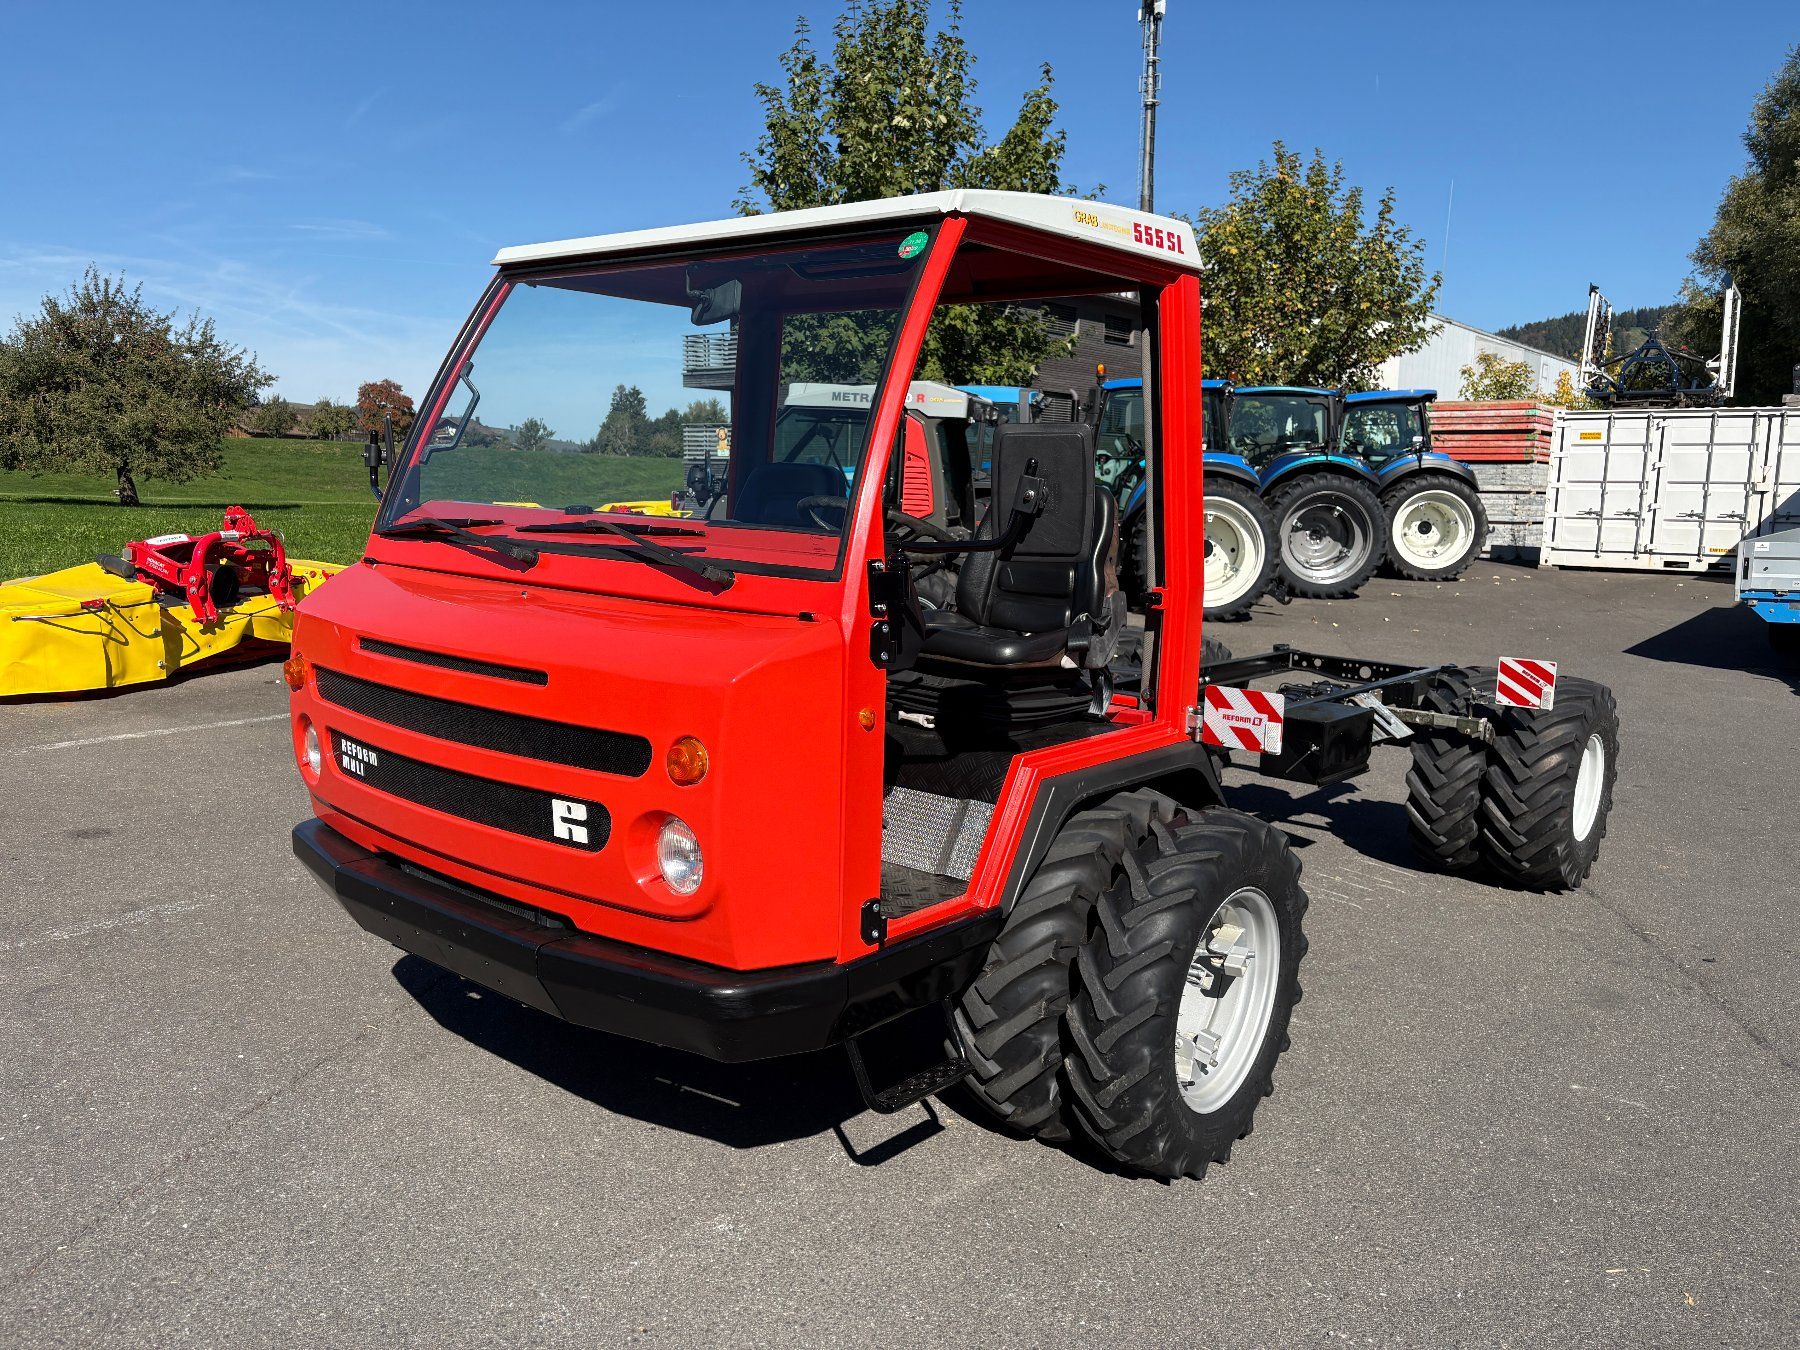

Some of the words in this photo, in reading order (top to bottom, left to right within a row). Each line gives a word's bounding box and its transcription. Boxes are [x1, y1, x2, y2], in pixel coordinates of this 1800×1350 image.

[1133, 222, 1165, 249] 555
[1166, 231, 1185, 255] SL
[831, 391, 873, 403] METR
[1222, 713, 1252, 724] REFORM
[341, 738, 378, 767] REFORM
[342, 754, 364, 777] MULI
